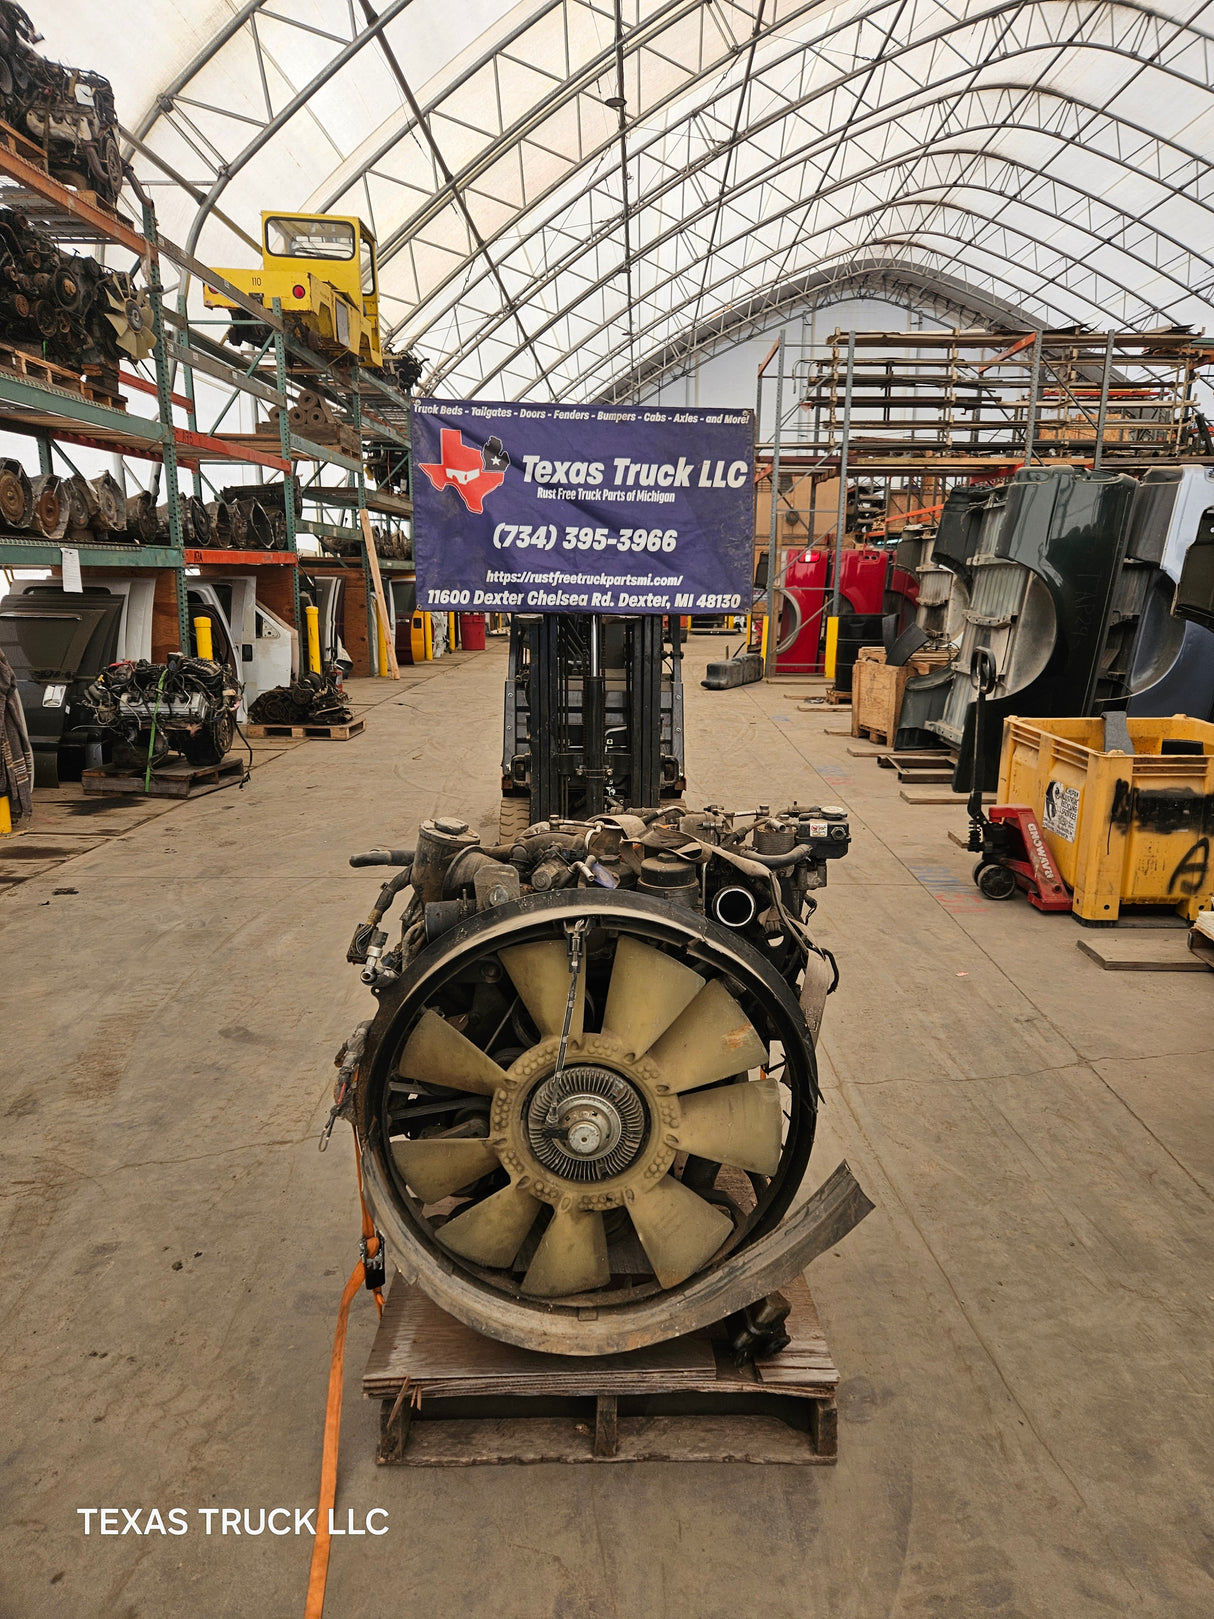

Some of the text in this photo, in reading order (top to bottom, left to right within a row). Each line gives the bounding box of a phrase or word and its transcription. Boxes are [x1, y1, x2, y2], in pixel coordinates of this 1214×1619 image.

[251, 277, 262, 287] 110
[414, 404, 439, 415] Truck
[440, 405, 463, 416] Beds
[471, 407, 512, 419] Tailgates
[520, 410, 546, 419] Doors
[554, 410, 590, 420] Fenders
[597, 411, 636, 423] Bumpers
[644, 412, 667, 422] Cabs
[673, 413, 699, 423] Axles
[705, 414, 723, 424] and
[724, 415, 750, 425] More!
[522, 454, 748, 489] Texas Truck LLC
[537, 487, 676, 504] Rust Free Truck Parts of Michigan
[493, 522, 678, 553] (734) 395-3966
[486, 569, 684, 588] https://rustfreetruckpartsmi.com/
[428, 589, 741, 609] 11600 Dexter Chelsea Rd. Dexter, MI 48130
[1027, 823, 1055, 879] RAYMOND
